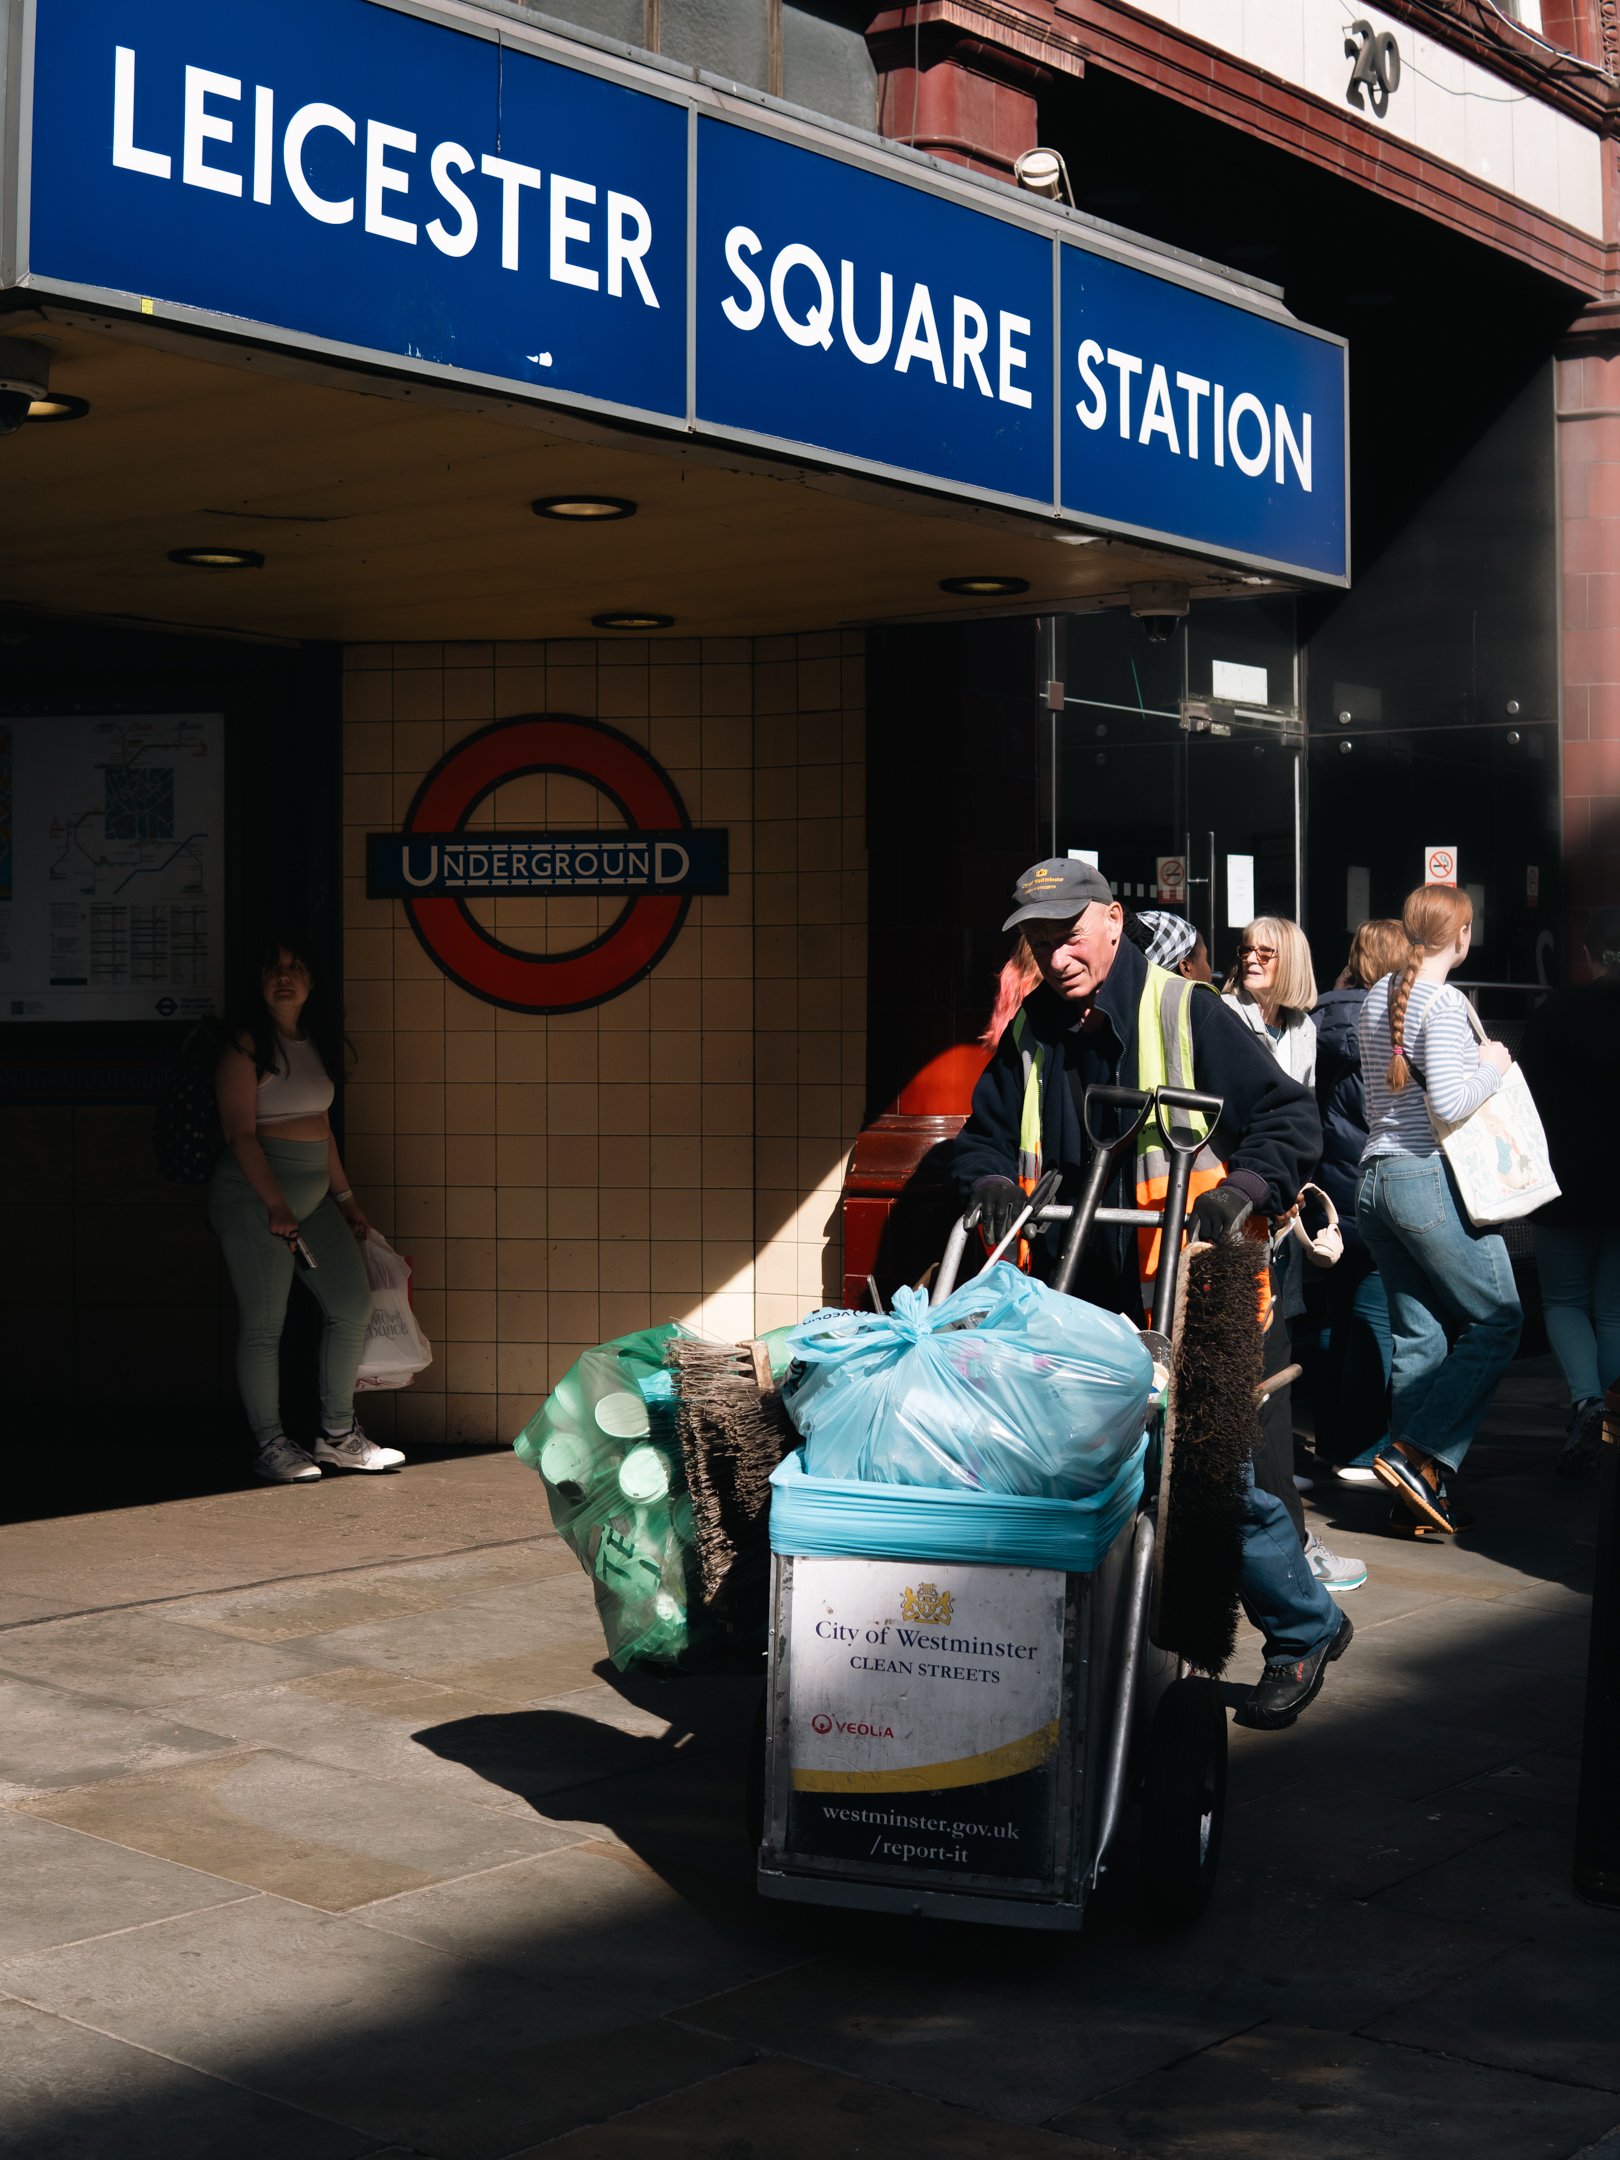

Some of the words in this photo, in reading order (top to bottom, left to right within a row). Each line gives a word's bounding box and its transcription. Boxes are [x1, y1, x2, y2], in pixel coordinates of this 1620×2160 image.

[1351, 19, 1400, 94] 20
[112, 45, 660, 309] LEICESTER
[721, 225, 1032, 410] SQUARE
[1075, 338, 1313, 493] STATION
[402, 842, 690, 888] UNDERGROUND
[815, 1620, 859, 1646] City
[865, 1626, 890, 1645] of
[896, 1628, 1038, 1661] Westminster
[850, 1656, 913, 1675] CLEAN
[918, 1663, 1000, 1684] STREETS
[835, 1721, 895, 1739] VEOLIA
[822, 1806, 1020, 1840] westminster.gov.uk
[870, 1834, 969, 1862] /report-it
